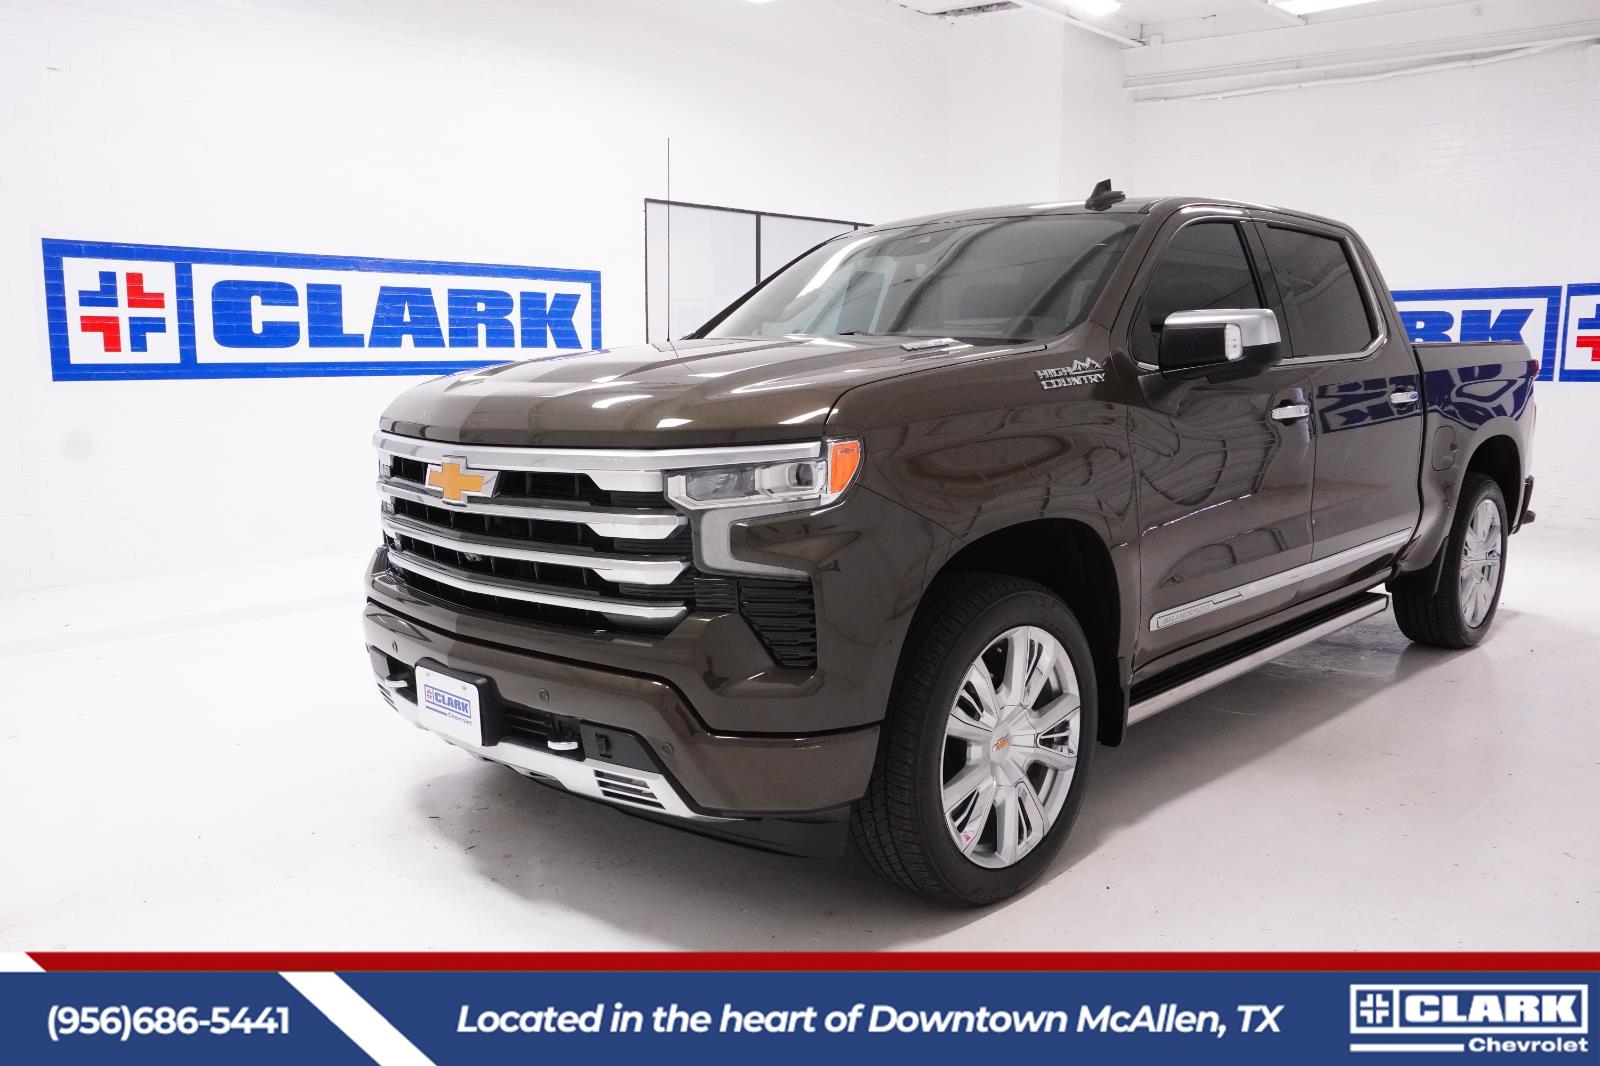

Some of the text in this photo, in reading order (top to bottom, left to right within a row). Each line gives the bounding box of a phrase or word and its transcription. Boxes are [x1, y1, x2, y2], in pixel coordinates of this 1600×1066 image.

[211, 279, 582, 349] CLARK
[1036, 366, 1073, 379] HIGH
[1040, 373, 1105, 389] COUNTRY
[434, 691, 469, 714] CLARK
